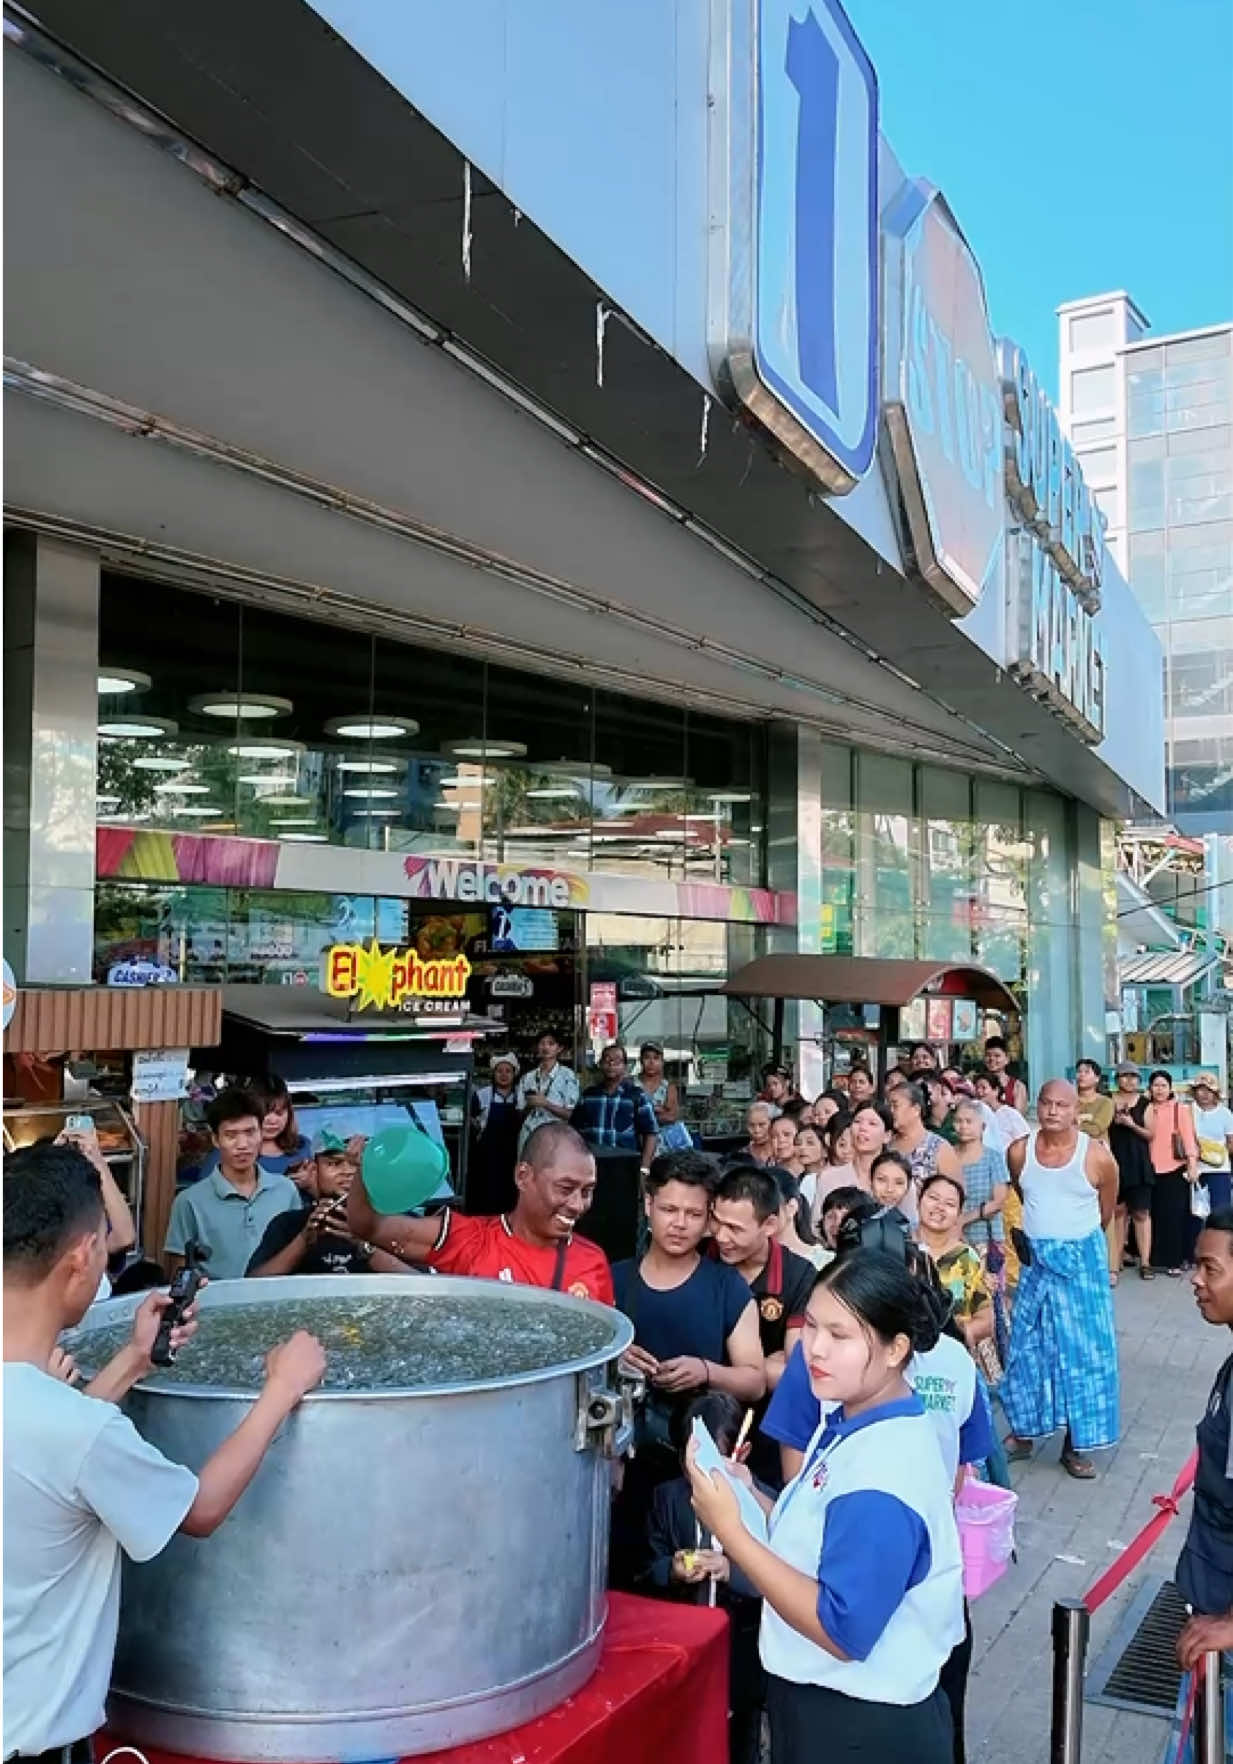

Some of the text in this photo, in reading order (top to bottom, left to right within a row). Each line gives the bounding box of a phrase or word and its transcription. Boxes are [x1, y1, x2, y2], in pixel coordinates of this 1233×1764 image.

[908, 283, 1001, 510] STOP
[428, 860, 569, 907] Welcome
[332, 951, 468, 1001] Elphant
[423, 1000, 471, 1012] CREAM
